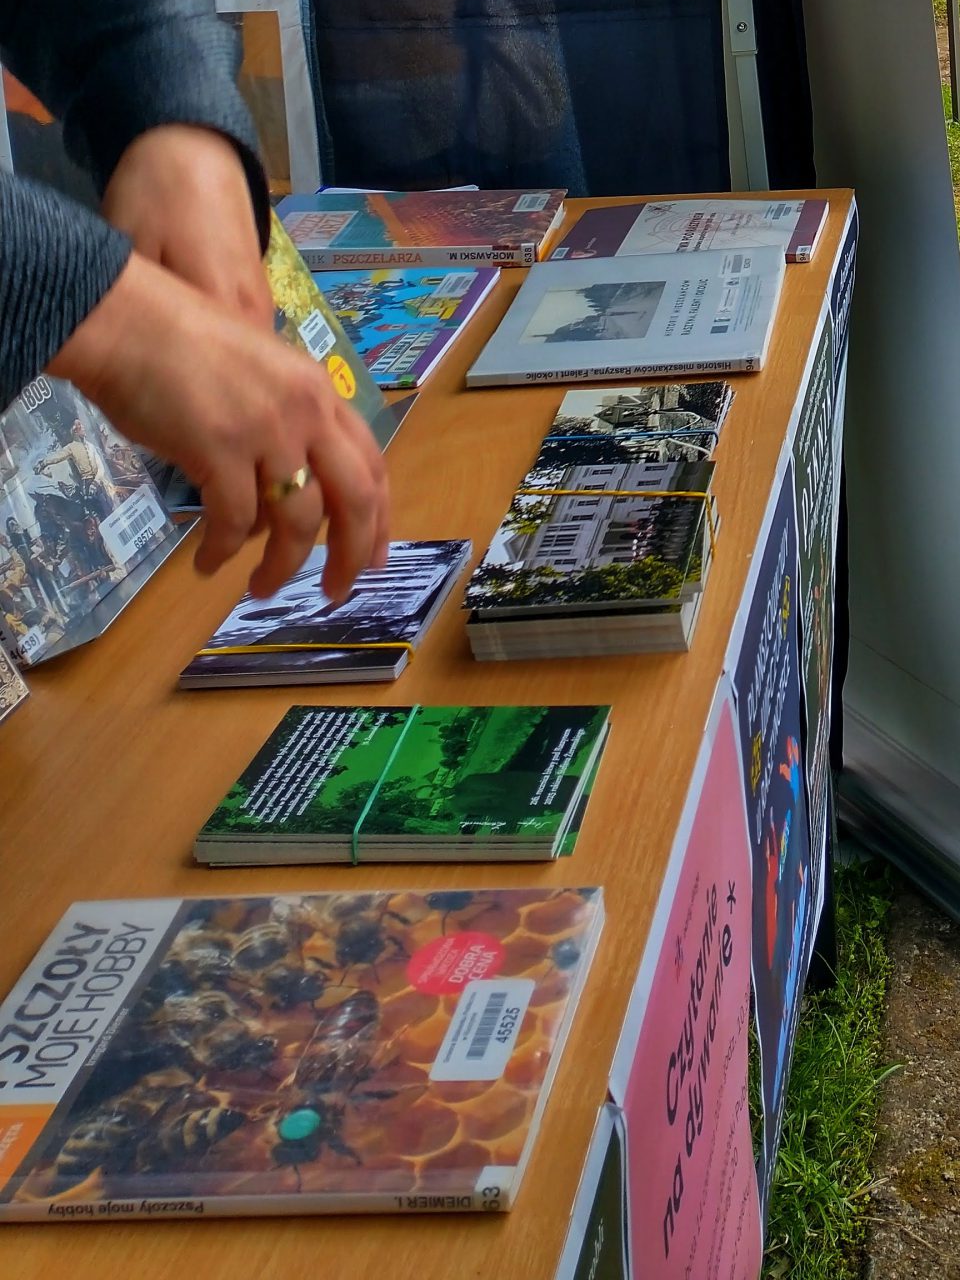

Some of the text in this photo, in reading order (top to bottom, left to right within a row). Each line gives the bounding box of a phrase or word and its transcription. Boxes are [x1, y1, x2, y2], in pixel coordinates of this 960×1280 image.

[332, 253, 423, 265] PSZCZELARZA
[447, 250, 514, 261] MORAWSKI M.
[524, 246, 533, 263] 638
[561, 368, 589, 380] Falent
[590, 365, 631, 378] Raszyna,
[634, 362, 694, 375] mieszkańców
[697, 360, 732, 372] Historie
[526, 371, 554, 382] okolic
[19, 375, 52, 413] 1809
[133, 526, 154, 549] 69570
[448, 944, 485, 983] DOBRA
[469, 951, 498, 981] CENA
[0, 921, 110, 1090] SZCZOŁY
[14, 922, 155, 1088] MOJE HOBBY
[666, 882, 718, 1126] Czytanie
[495, 1007, 520, 1044] 45525
[663, 1153, 685, 1259] na
[684, 921, 733, 1158] dywanie
[48, 1200, 204, 1218] Pszczoły moje hobby
